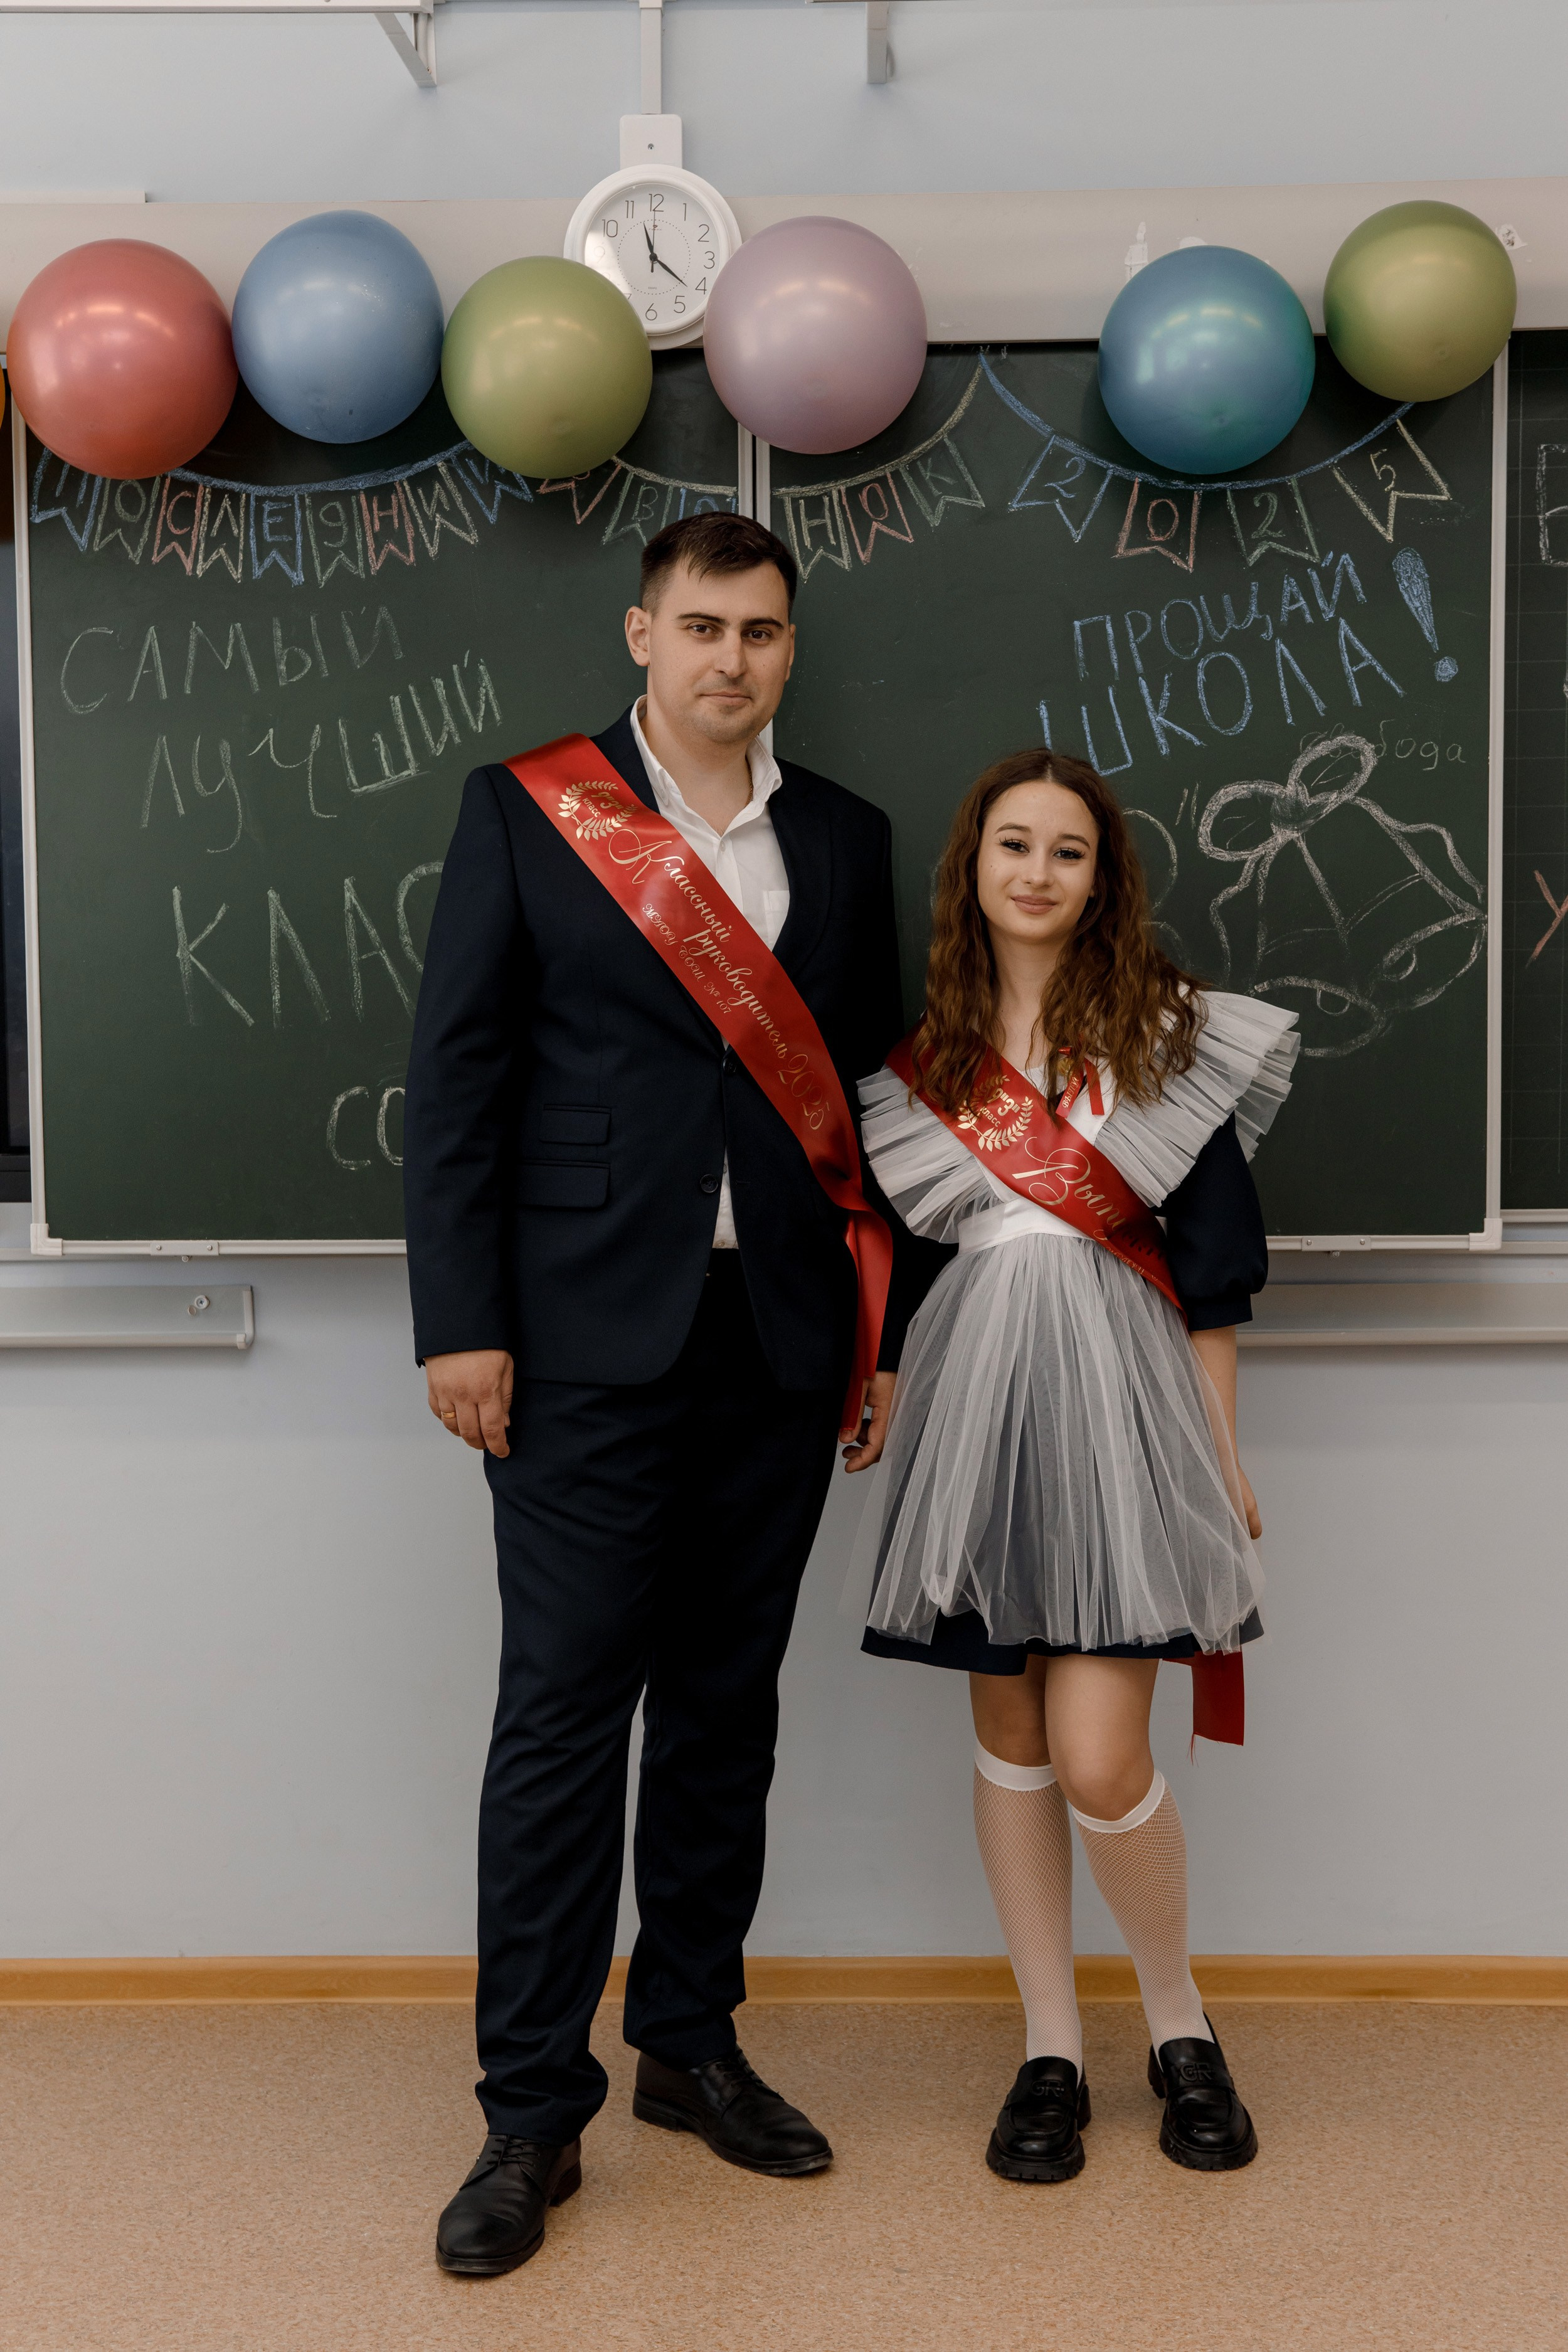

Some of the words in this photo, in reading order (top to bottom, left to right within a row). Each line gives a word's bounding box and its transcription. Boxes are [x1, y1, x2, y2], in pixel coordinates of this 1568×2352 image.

[625, 200, 635, 219] 11
[649, 193, 664, 212] 12
[682, 203, 687, 221] 1
[601, 219, 618, 238] 10
[697, 224, 710, 243] 2
[703, 251, 715, 269] 3
[695, 277, 707, 295] 4
[645, 302, 658, 320] 6
[673, 295, 686, 314] 5
[1073, 551, 1367, 681] ПРОЩАЙ
[60, 605, 404, 715] САМЫЙ
[139, 649, 502, 854] ЛУЧШИЙ
[582, 797, 601, 818] класс
[608, 829, 734, 943] Классный
[682, 928, 788, 1060] руководитель
[775, 1054, 830, 1130] 2025
[980, 1106, 1001, 1128] класс
